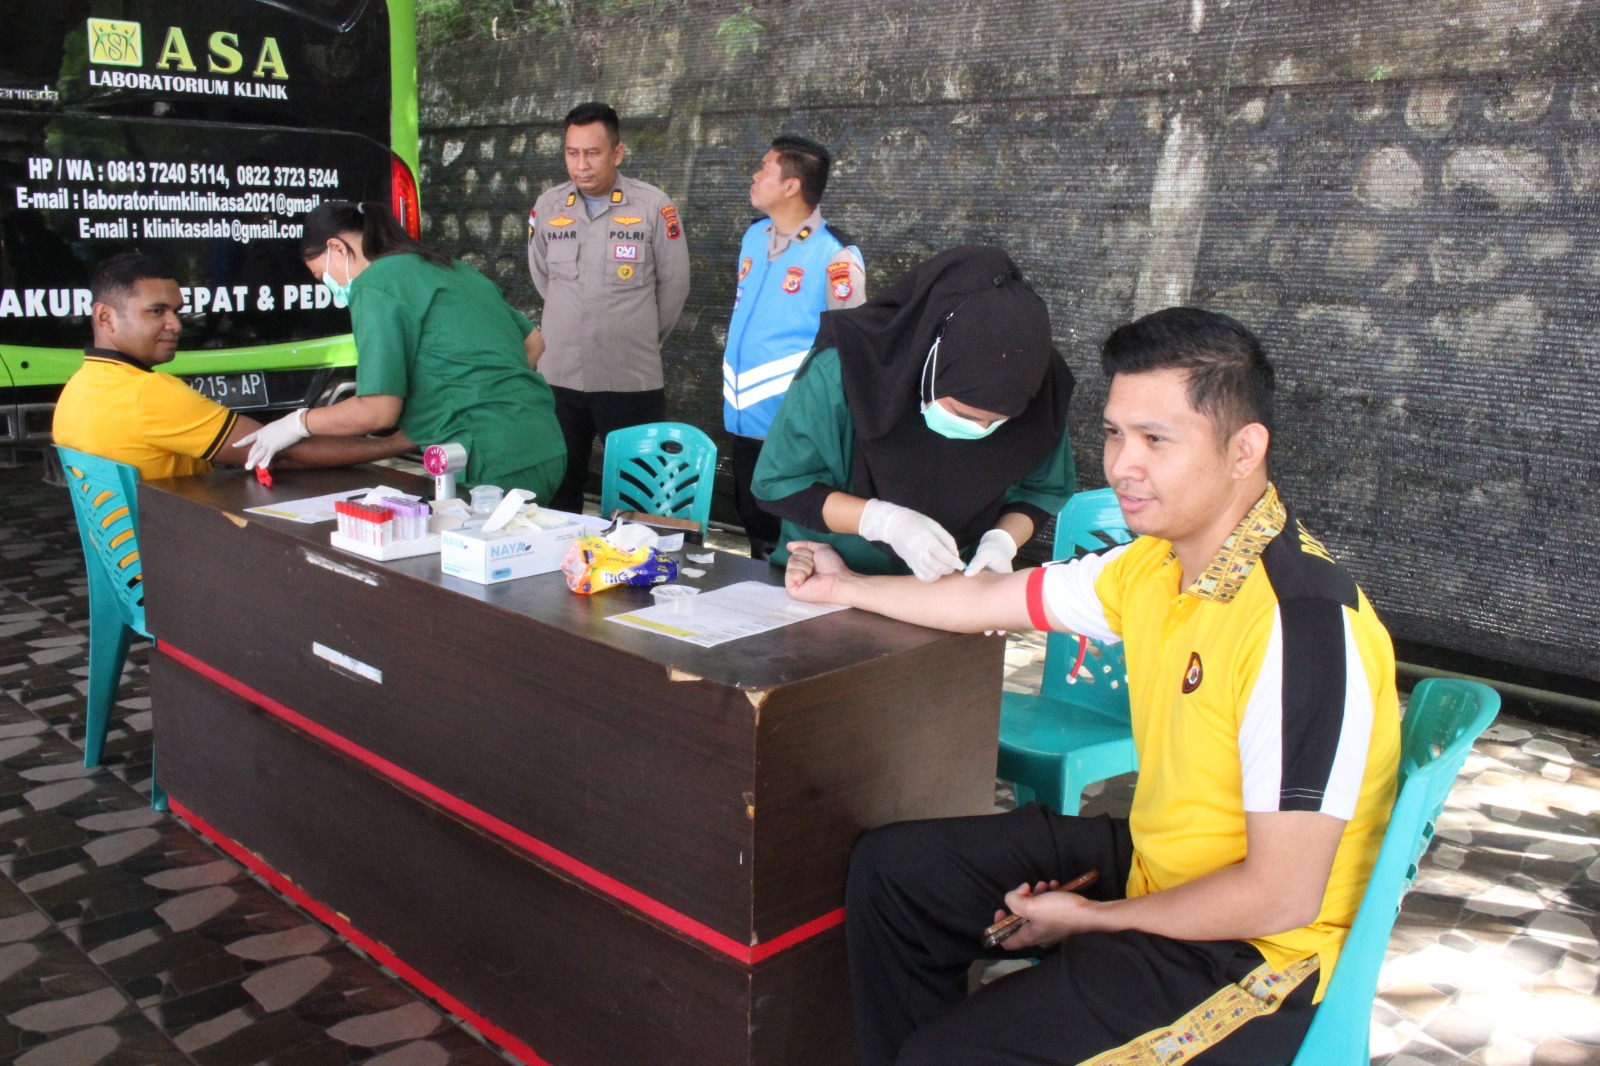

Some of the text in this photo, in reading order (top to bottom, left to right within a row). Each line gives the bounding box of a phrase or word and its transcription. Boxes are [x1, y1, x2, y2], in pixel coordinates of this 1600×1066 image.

[156, 26, 289, 80] ASA
[0, 84, 59, 101] armada
[89, 69, 289, 100] LABORATORIUM KLINIK
[28, 157, 53, 180] HP
[57, 158, 63, 181] /
[66, 158, 95, 181] WA
[107, 160, 146, 183] 0813
[149, 162, 187, 184] 7240
[190, 163, 230, 189] 5114,
[236, 165, 270, 186] 0822
[274, 166, 306, 187] 3723
[308, 168, 339, 188] 5244
[16, 186, 69, 210] E-mail
[83, 188, 348, 217] laboratoriumklinikasa2021@gmail
[79, 217, 129, 239] E-mail
[547, 230, 577, 241] FAJAR
[609, 230, 645, 241] POLRI
[0, 287, 94, 318] AKUR
[178, 285, 249, 314] EPAT
[257, 284, 275, 311] &
[241, 373, 261, 396] AP
[442, 535, 465, 550] NAYA
[490, 541, 527, 558] NAYA
